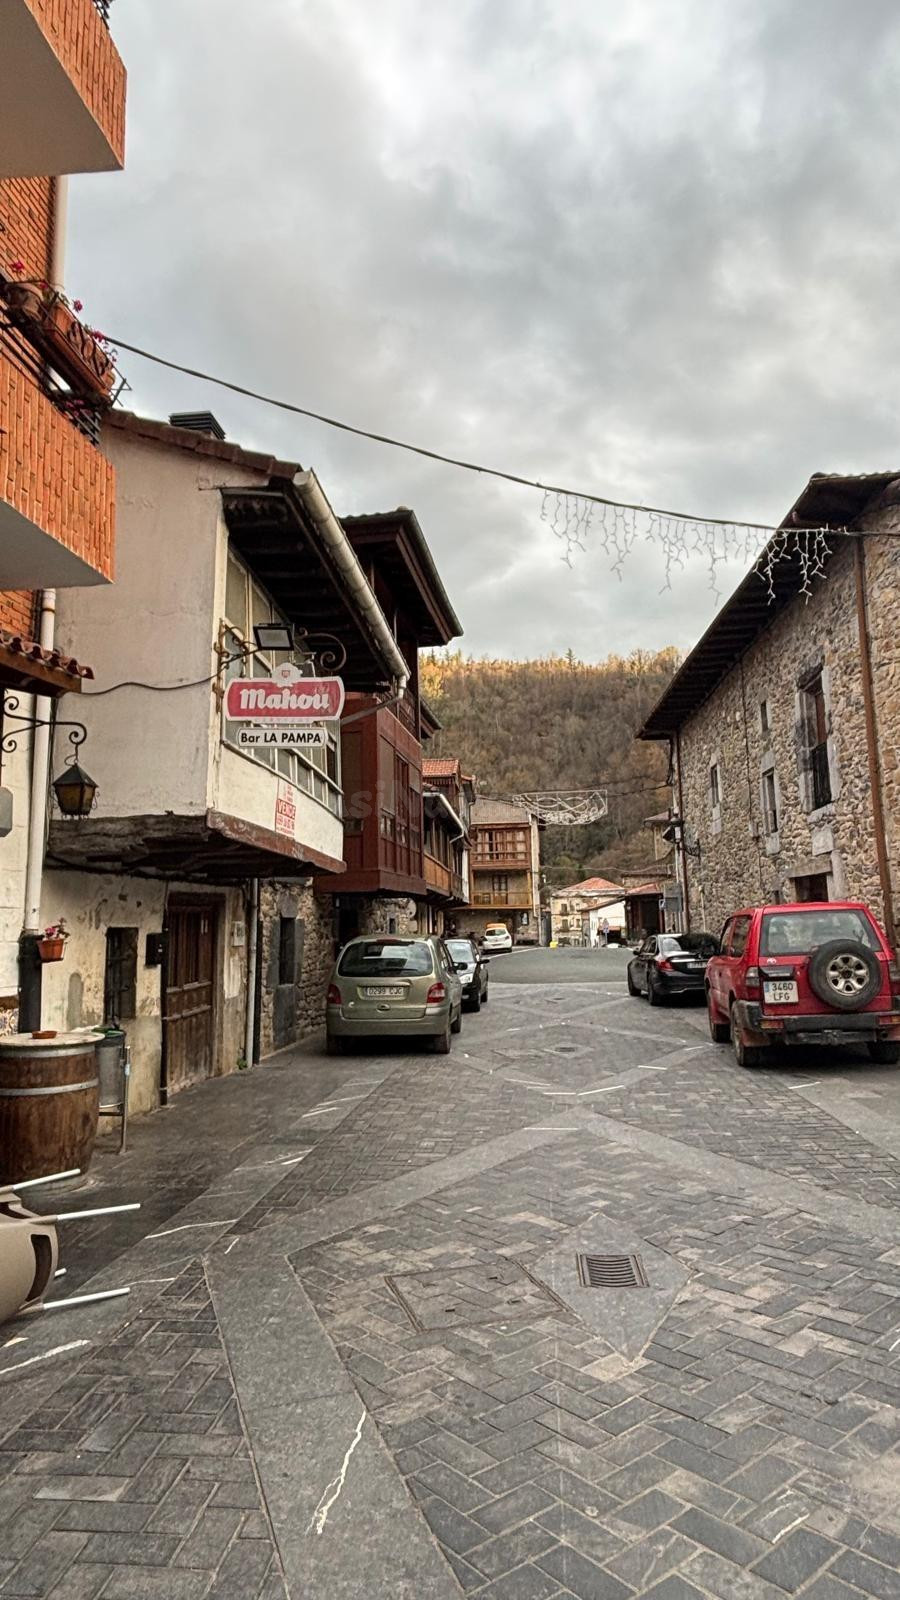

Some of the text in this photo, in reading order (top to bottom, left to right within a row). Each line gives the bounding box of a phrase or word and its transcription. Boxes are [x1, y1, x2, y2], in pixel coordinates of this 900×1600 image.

[240, 689, 329, 709] Mahou
[241, 733, 321, 743] Bar LA PAMPA
[773, 992, 790, 1001] LFG
